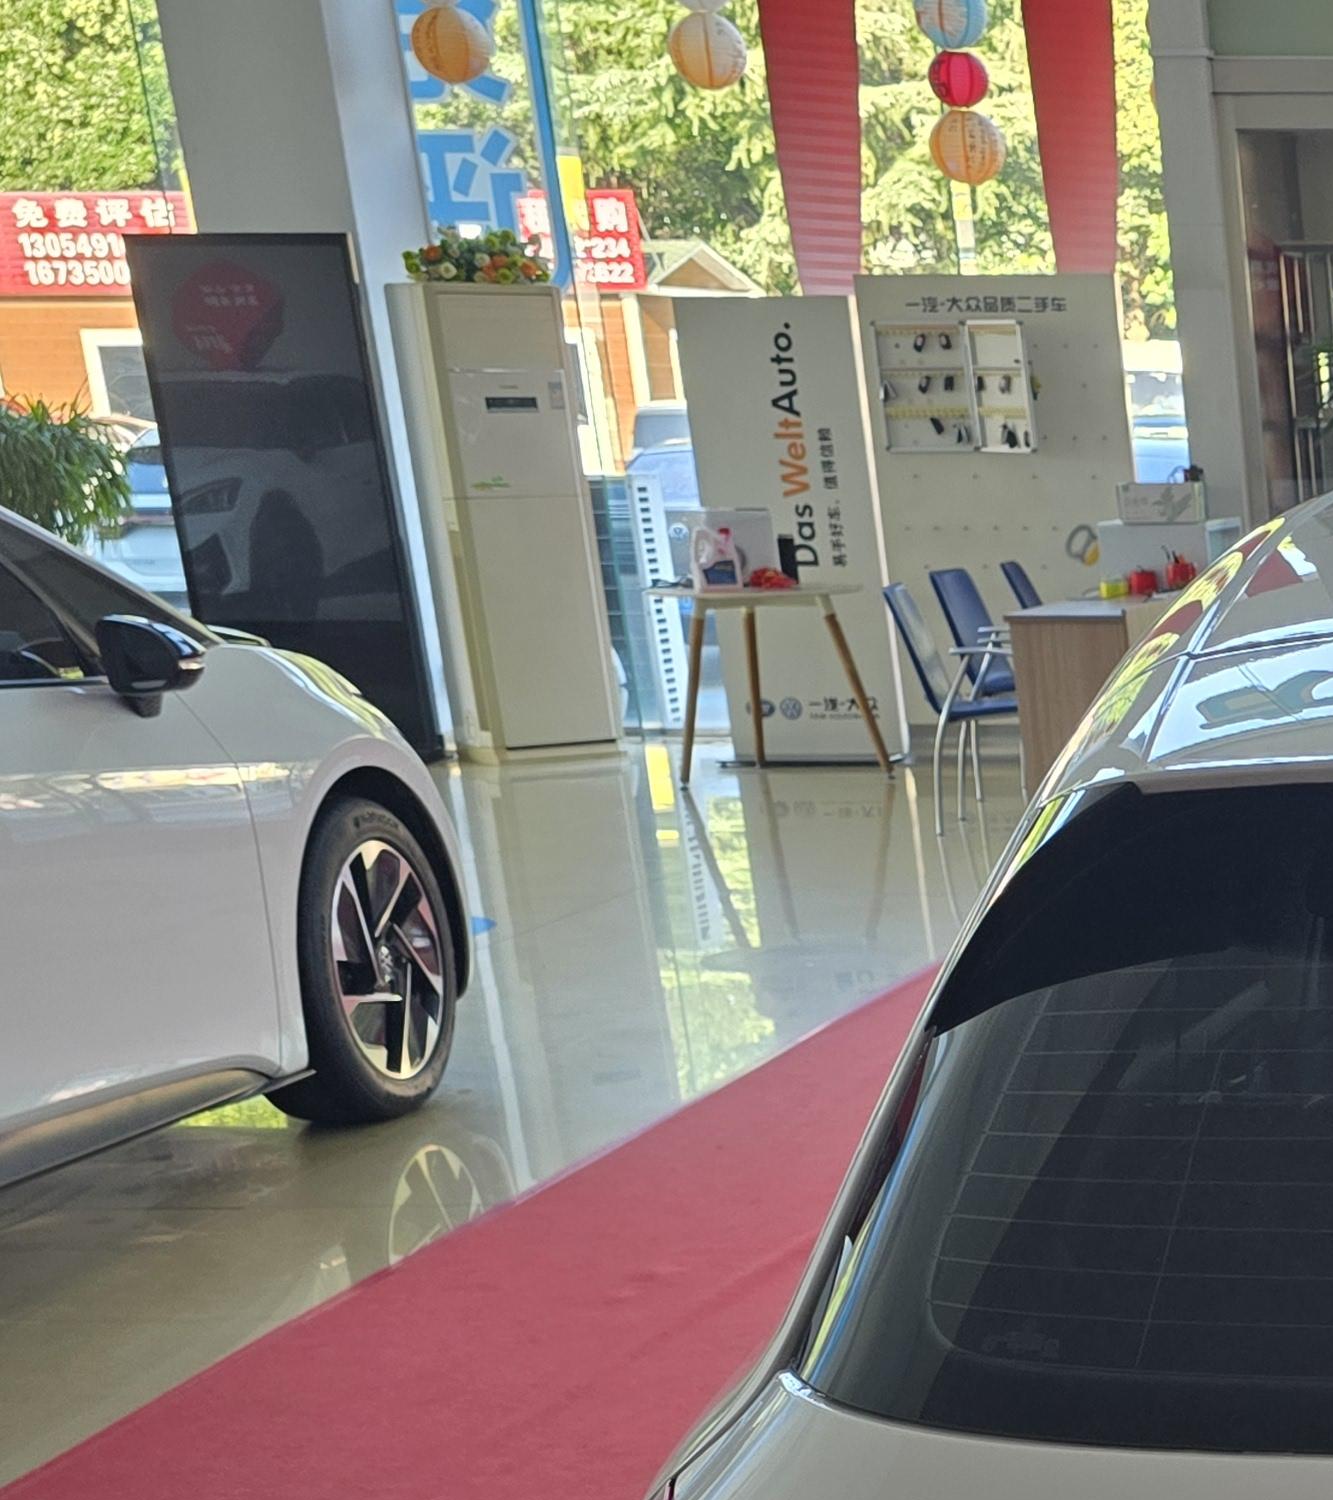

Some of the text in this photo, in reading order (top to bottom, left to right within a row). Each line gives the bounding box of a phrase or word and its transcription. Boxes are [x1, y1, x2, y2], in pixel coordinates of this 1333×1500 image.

[12, 198, 176, 228] 免费评估
[770, 321, 820, 567] Das WeltAuto.
